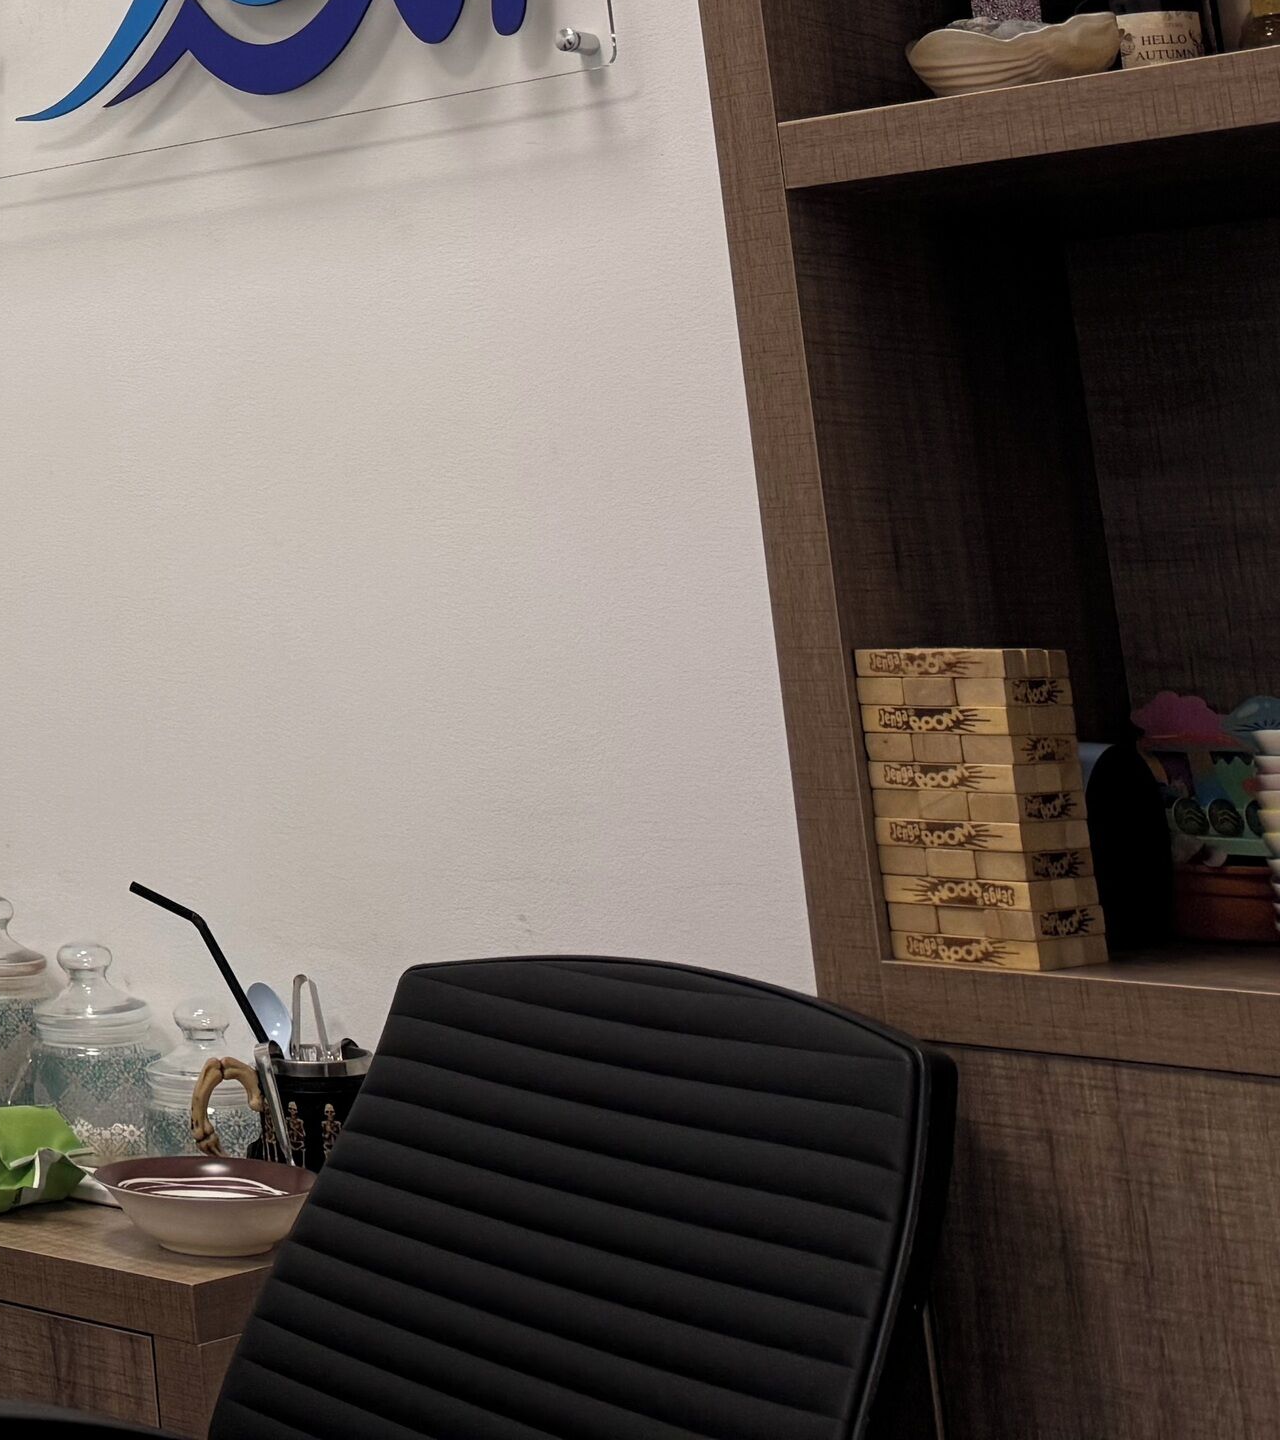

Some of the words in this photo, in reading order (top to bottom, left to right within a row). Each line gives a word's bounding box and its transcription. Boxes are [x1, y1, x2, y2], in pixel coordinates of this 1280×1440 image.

[1141, 33, 1188, 46] HELLO
[1136, 48, 1197, 61] AUTUMN
[869, 652, 900, 672] Jenga
[879, 708, 908, 730] Jenga
[909, 709, 965, 731] BOOM
[884, 764, 914, 786] Jenga
[914, 765, 970, 788] BOOM
[890, 822, 920, 844] Jenga
[921, 824, 976, 846] BOOM
[907, 936, 937, 958] Jenga
[938, 939, 993, 961] BOOM
